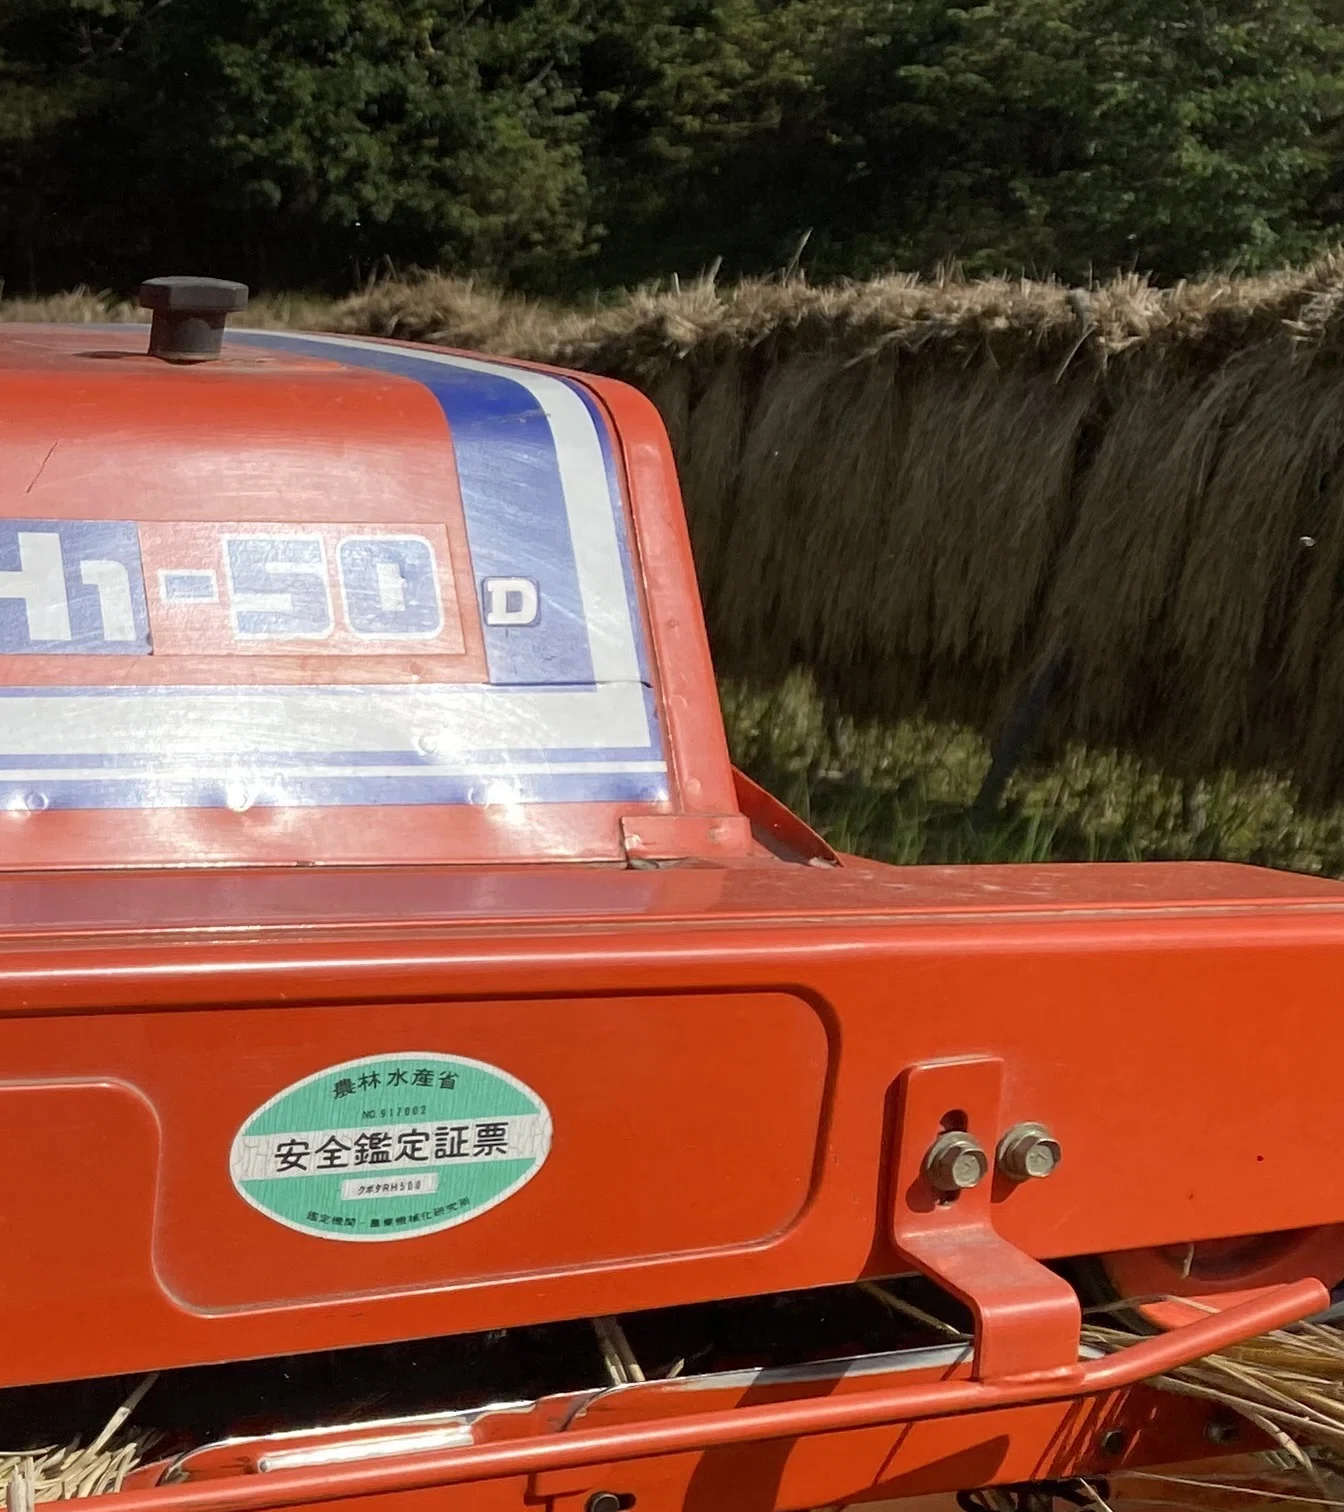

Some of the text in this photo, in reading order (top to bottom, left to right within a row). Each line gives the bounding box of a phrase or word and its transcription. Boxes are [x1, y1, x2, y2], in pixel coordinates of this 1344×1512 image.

[486, 577, 539, 625] D
[332, 1068, 460, 1099] 農林水産省
[274, 1121, 509, 1173] 安全鑑定証票
